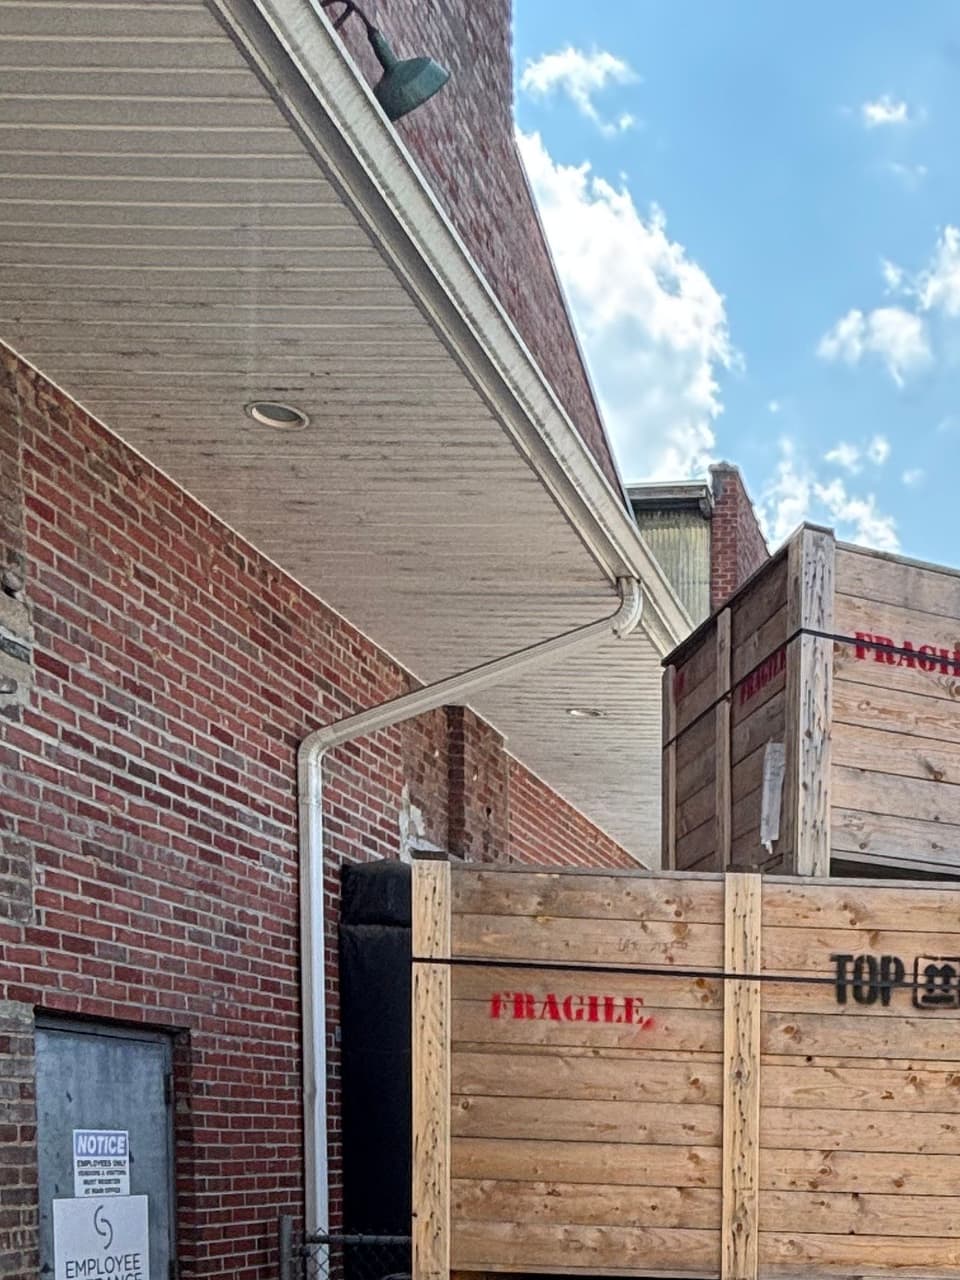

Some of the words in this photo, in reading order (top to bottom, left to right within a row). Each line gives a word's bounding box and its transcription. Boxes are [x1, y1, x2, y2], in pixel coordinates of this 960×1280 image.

[829, 953, 905, 1007] TOP
[490, 991, 645, 1025] FRAGILE
[77, 1135, 126, 1154] NOTICE
[65, 1253, 141, 1279] EMPLOYEE
